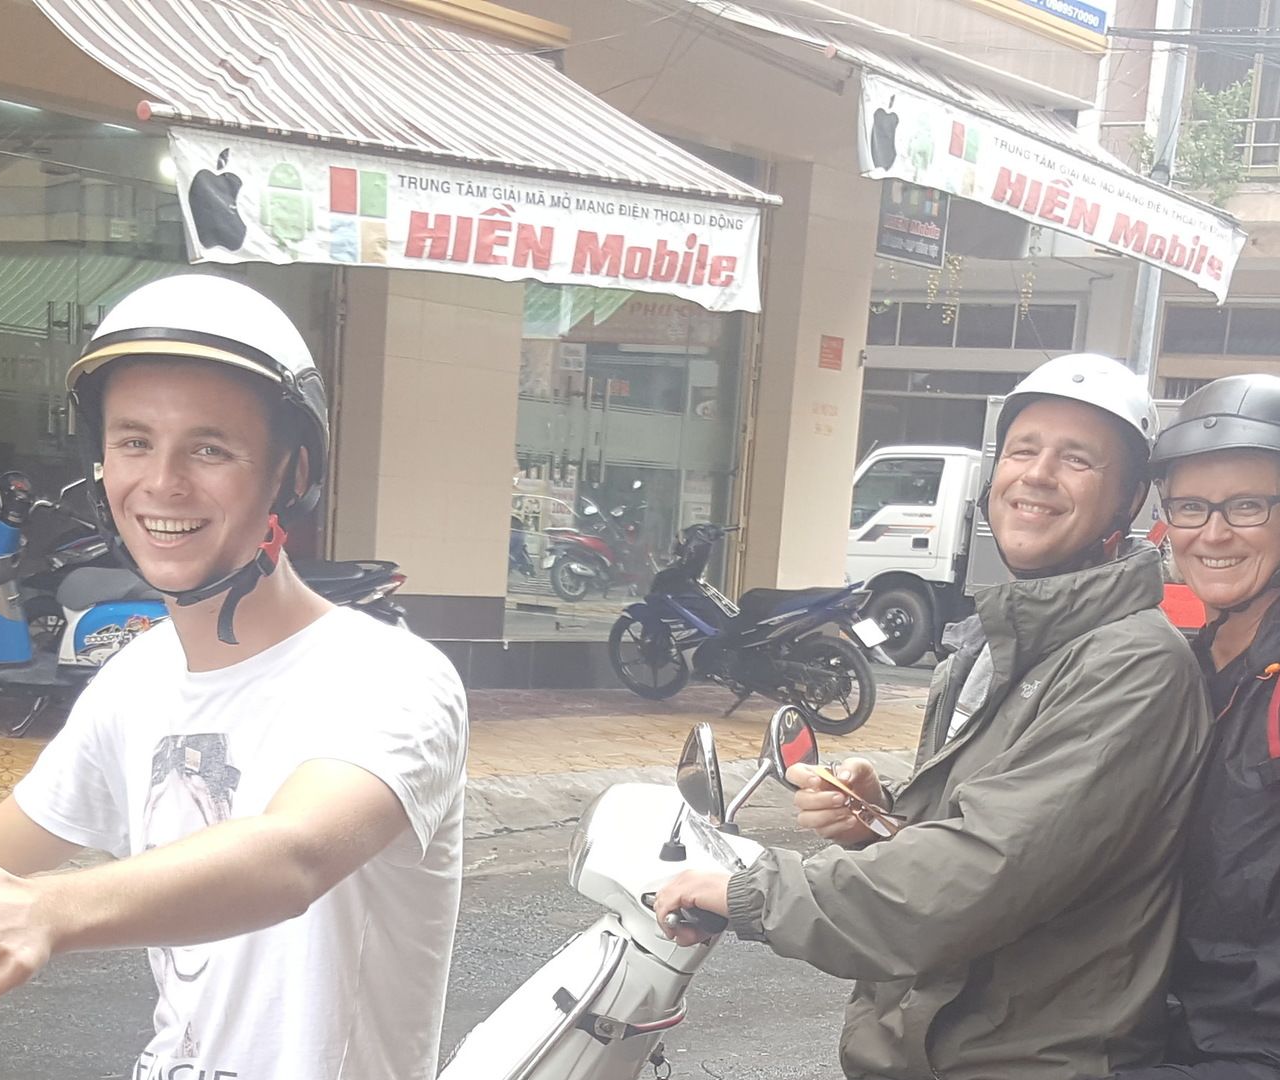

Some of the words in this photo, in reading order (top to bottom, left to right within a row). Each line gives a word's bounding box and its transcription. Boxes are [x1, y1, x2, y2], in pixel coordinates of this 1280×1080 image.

[993, 136, 1031, 160] TRUNG
[397, 174, 451, 194] TRUNG
[456, 180, 488, 199] TÂM
[492, 182, 521, 202] GIẢI
[525, 190, 546, 206] MÃ
[693, 213, 706, 226] DI
[709, 213, 744, 231] ĐỘNG
[990, 165, 1101, 236] HIỀN
[1107, 211, 1224, 281] Mobile
[404, 203, 555, 271] HIỀN
[570, 229, 738, 288] Mobile
